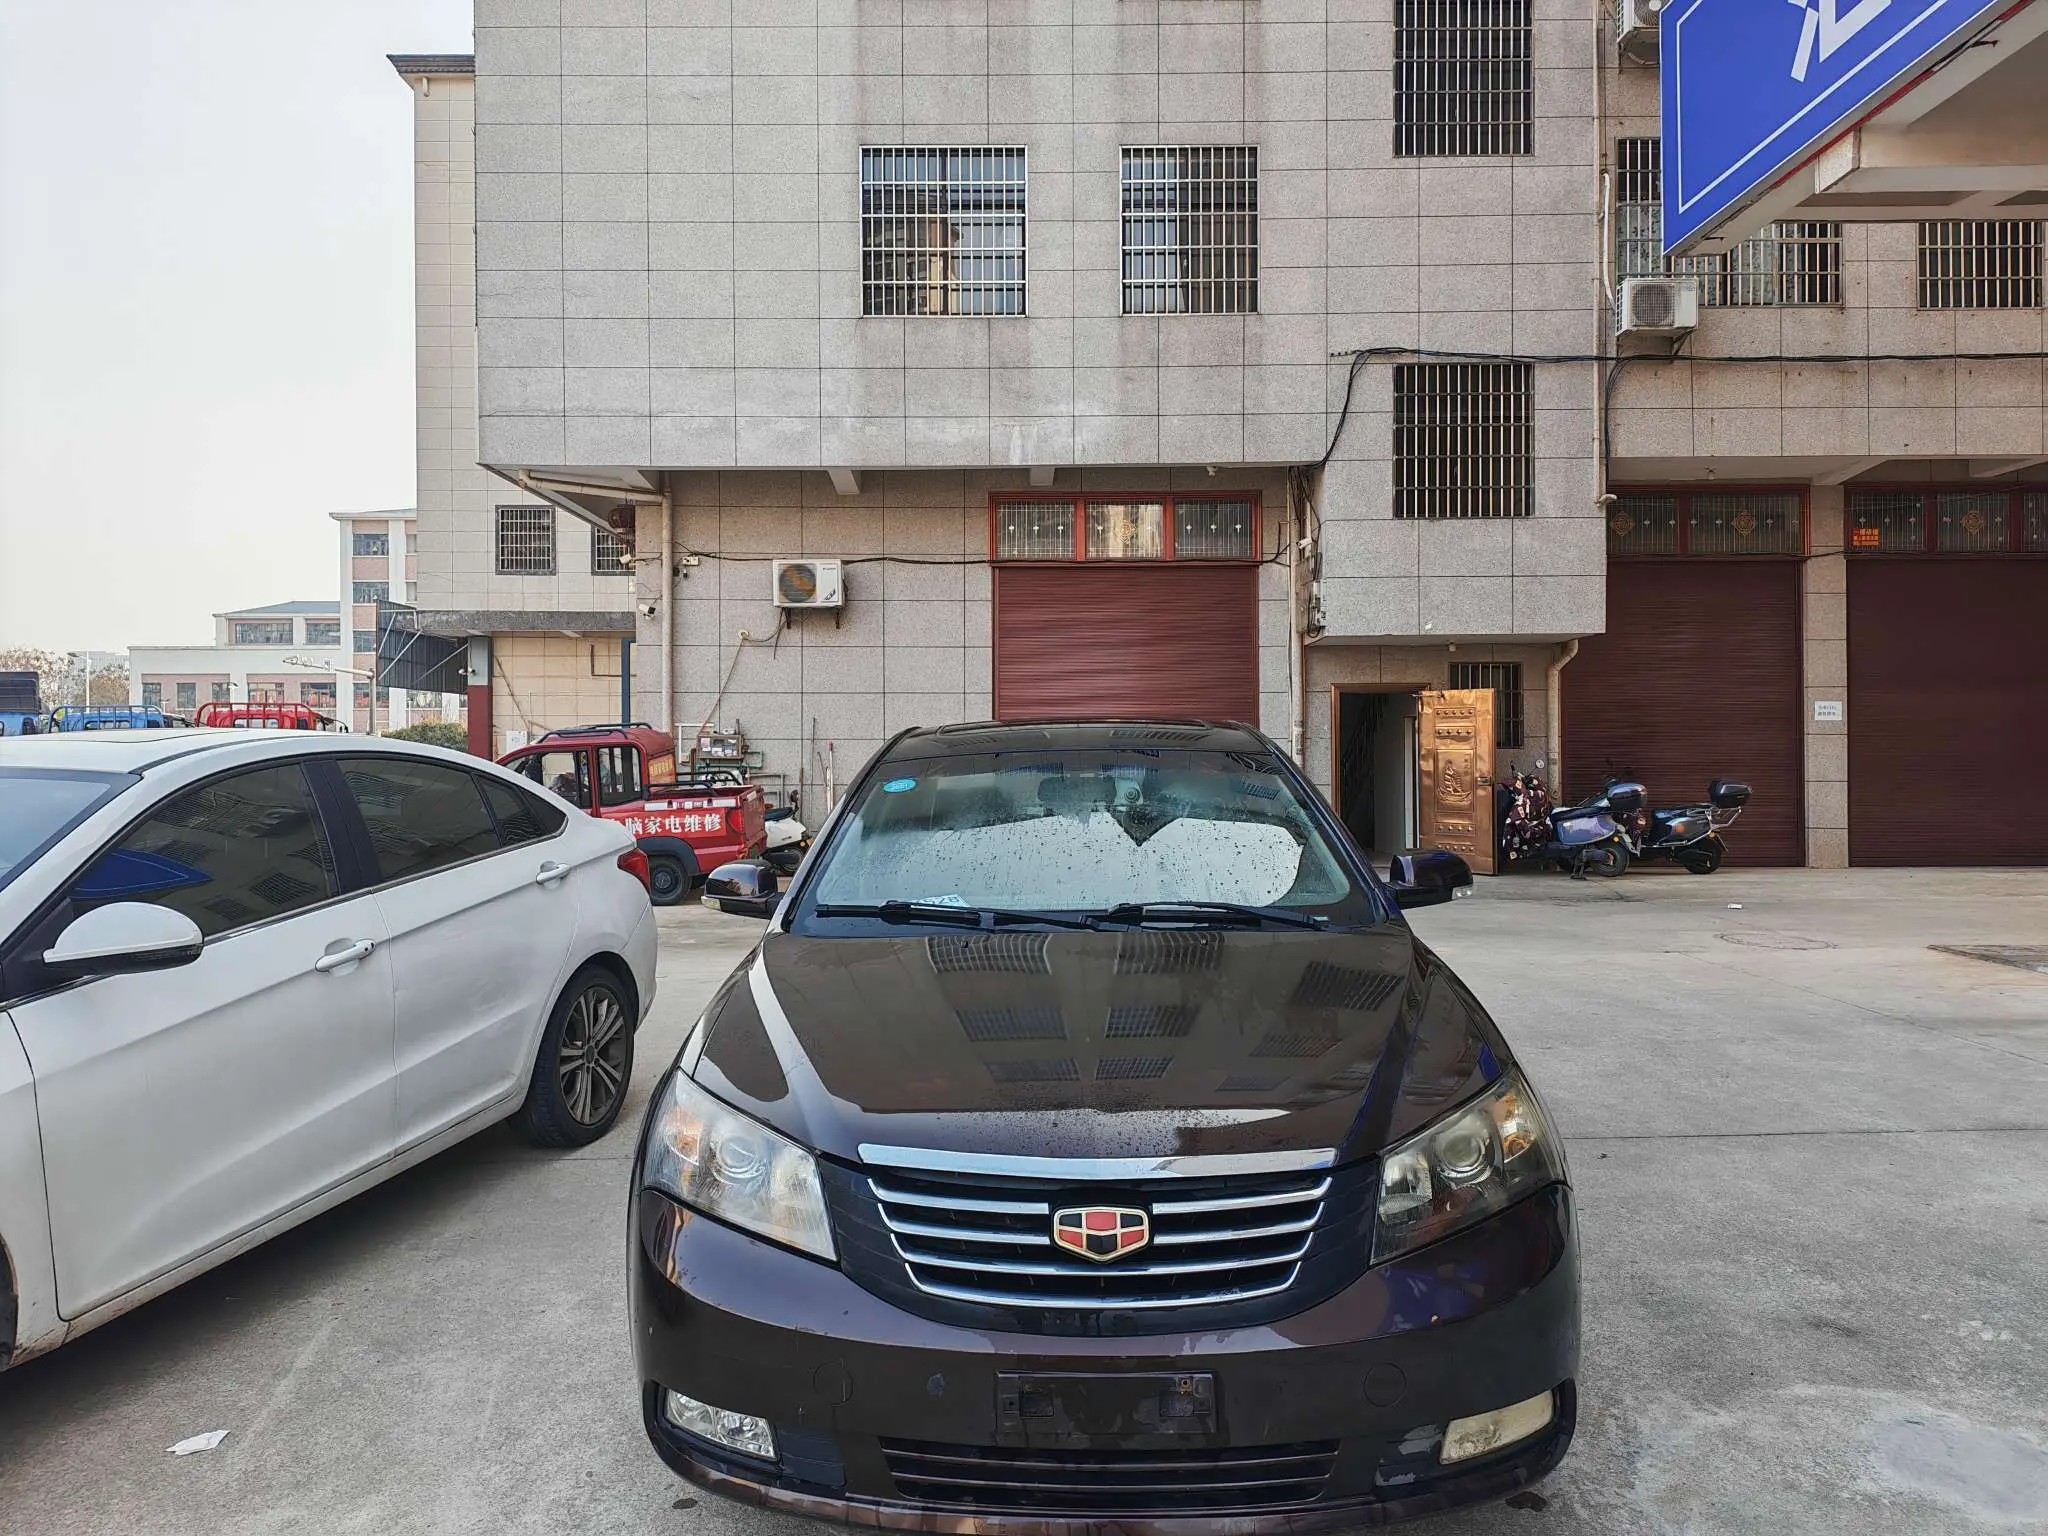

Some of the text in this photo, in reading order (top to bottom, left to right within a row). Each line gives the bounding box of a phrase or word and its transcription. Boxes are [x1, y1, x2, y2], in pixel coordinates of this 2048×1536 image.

[610, 813, 721, 834] 脑家电维修
